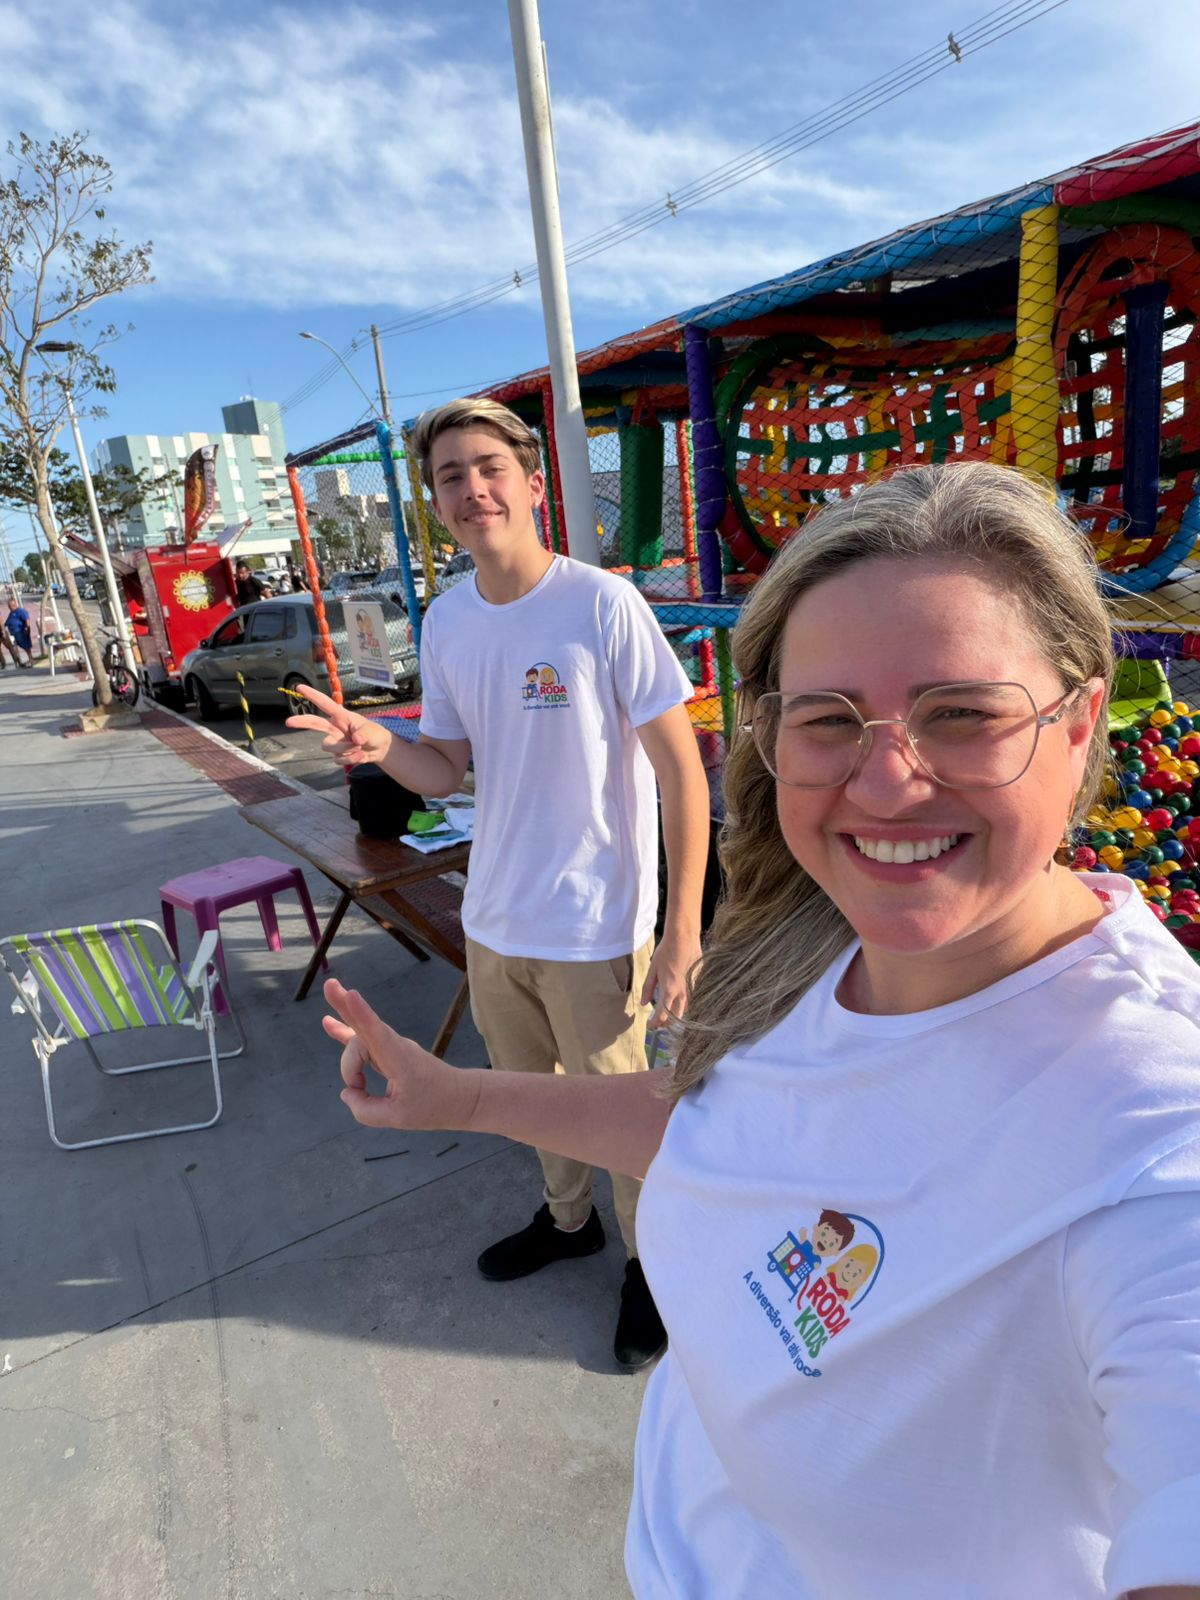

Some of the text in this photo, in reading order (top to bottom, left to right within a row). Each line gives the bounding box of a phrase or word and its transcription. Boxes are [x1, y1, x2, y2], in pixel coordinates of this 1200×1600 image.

[540, 685, 567, 694] RODA
[544, 694, 567, 702] KIDS
[743, 1271, 754, 1284] A
[750, 1280, 782, 1328] diversão
[779, 1326, 794, 1346] vai
[788, 1342, 801, 1360] até
[794, 1306, 828, 1358] KIDS
[806, 1277, 851, 1339] RODA
